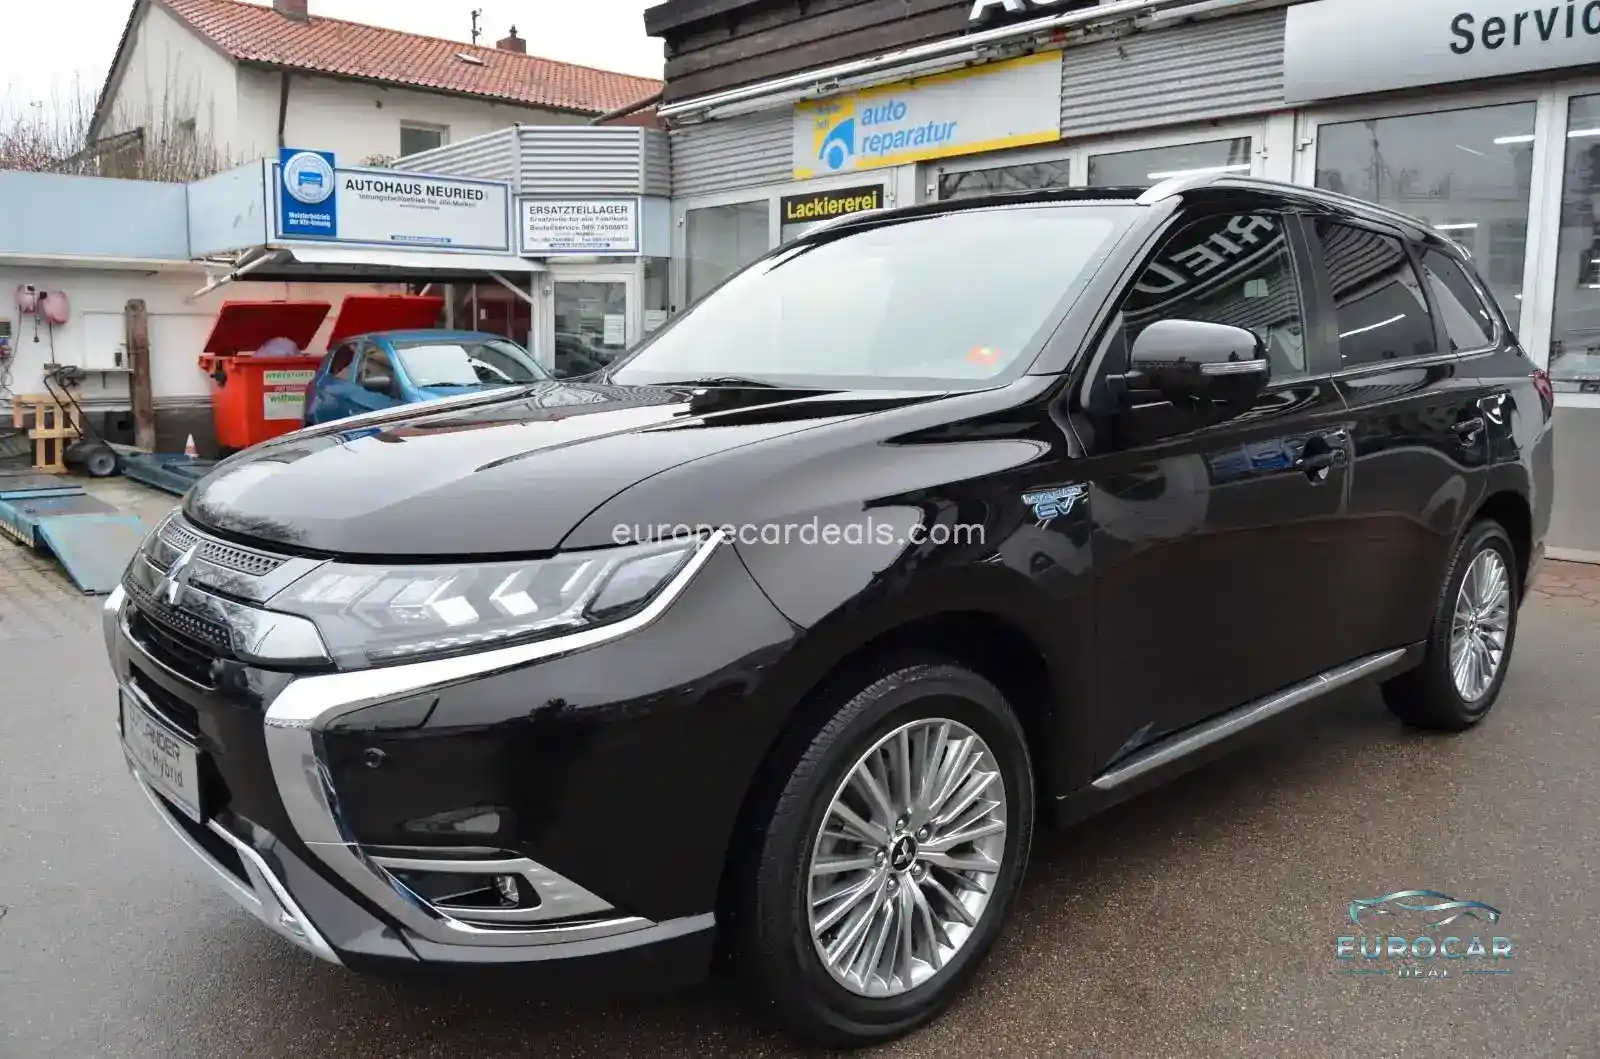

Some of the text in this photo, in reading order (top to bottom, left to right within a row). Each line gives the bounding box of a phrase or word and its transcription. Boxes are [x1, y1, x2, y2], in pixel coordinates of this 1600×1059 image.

[861, 100, 907, 126] auto
[861, 120, 958, 156] reparatur
[345, 178, 484, 201] AUTOHAUS NEURIED
[529, 205, 628, 215] ERSATZTEILLAGER
[787, 190, 877, 219] Lackiererei
